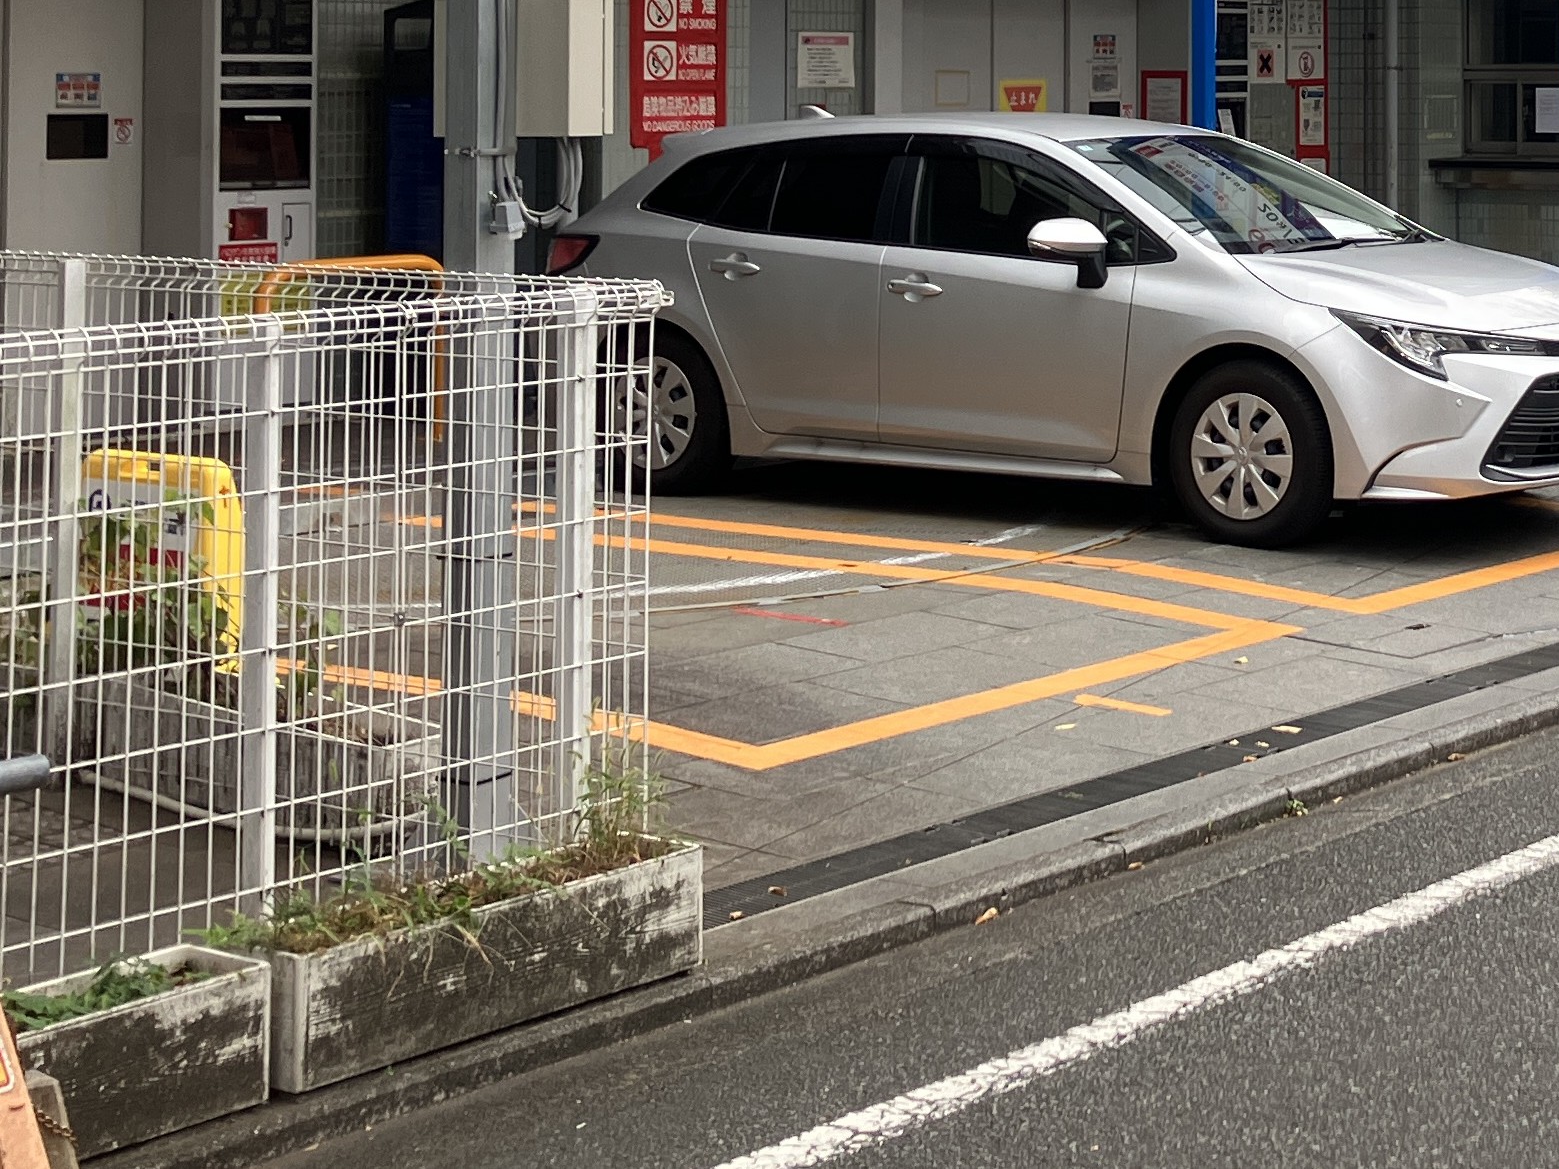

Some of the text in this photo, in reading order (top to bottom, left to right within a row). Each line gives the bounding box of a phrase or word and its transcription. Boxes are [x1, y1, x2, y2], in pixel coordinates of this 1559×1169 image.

[678, 44, 716, 66] 火気厳禁
[1009, 91, 1037, 106] 止まれ
